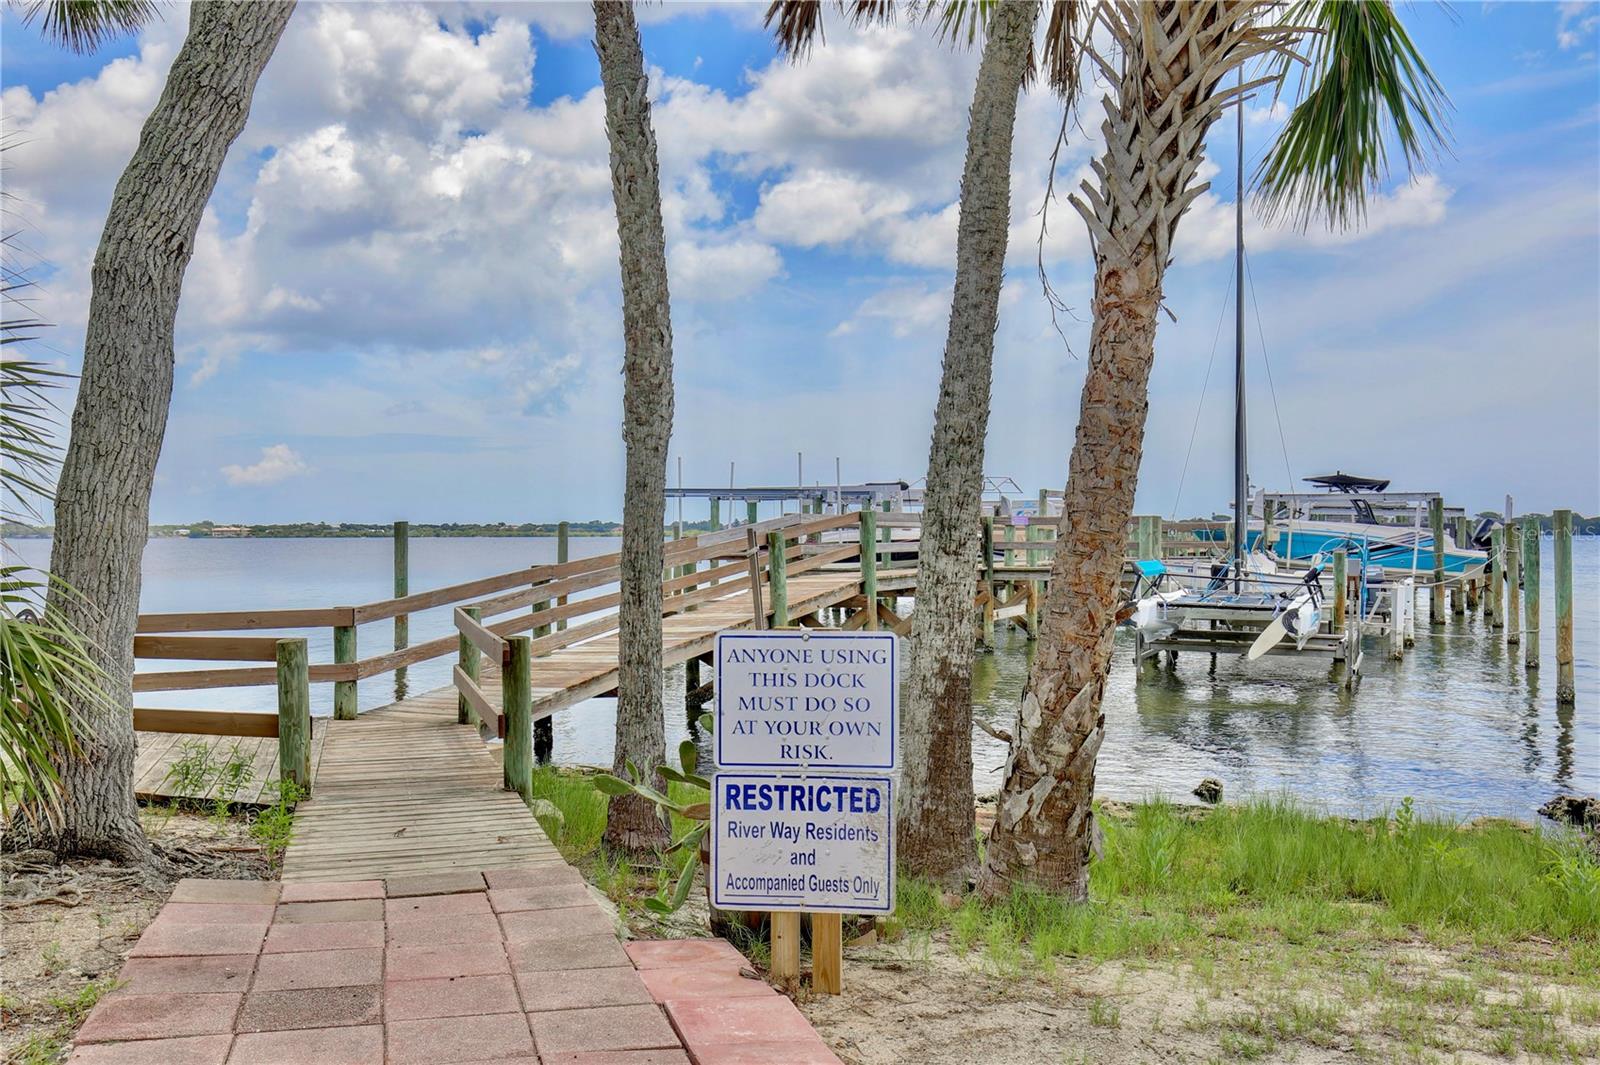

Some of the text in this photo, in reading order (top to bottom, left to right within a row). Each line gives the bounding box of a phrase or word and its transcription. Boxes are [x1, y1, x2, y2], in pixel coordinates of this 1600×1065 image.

[727, 649, 887, 665] ANYONE USING
[749, 672, 867, 689] THIS DOCK
[738, 696, 871, 713] MUST DO SO
[732, 720, 881, 737] AT YOUR OWN
[780, 745, 833, 760] RISK.
[725, 784, 881, 813] RESTRICTED
[727, 821, 879, 844] River Way Residents
[790, 849, 816, 866] and
[726, 873, 880, 898] Accompanied Guests Only
